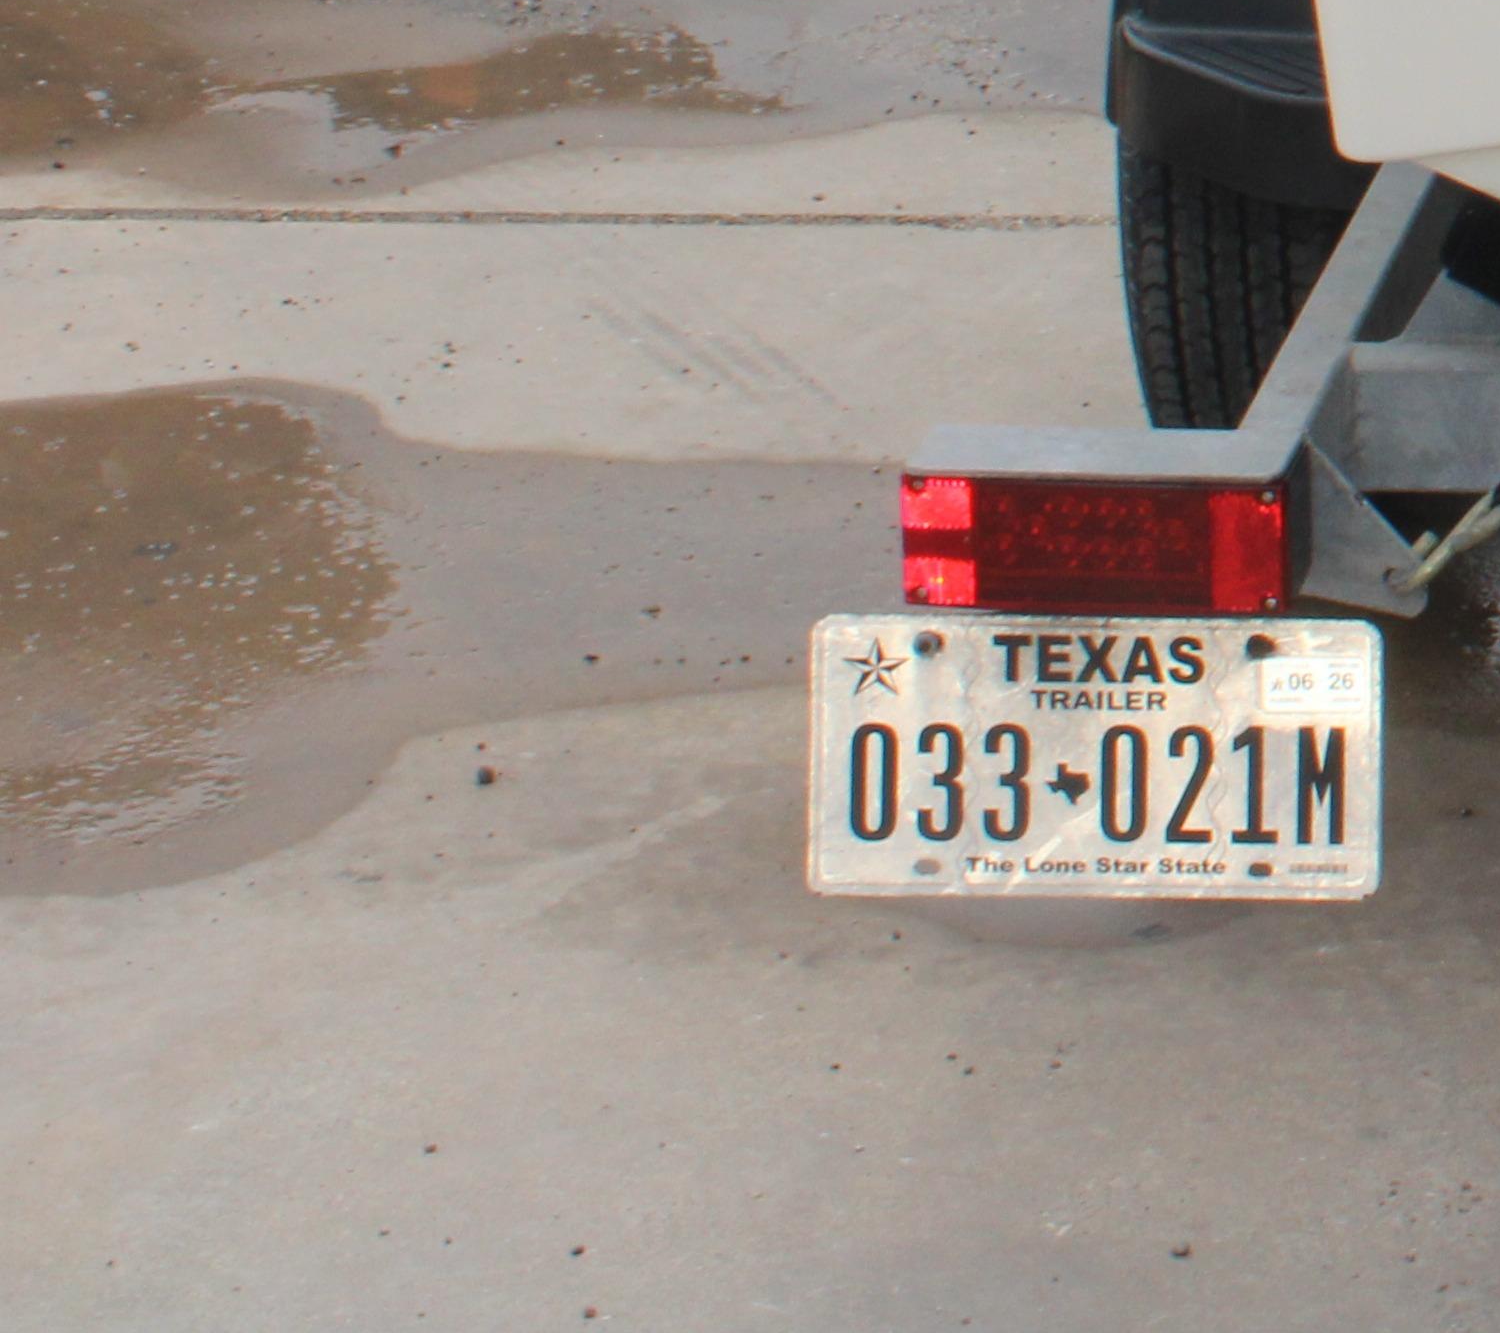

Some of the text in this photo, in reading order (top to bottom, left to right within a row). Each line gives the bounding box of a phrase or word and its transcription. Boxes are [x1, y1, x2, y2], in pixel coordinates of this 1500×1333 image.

[993, 635, 1206, 683] TEXAS
[1288, 673, 1354, 690] 06 26
[1031, 690, 1167, 711] TRAILER
[851, 722, 1346, 844] 033 021M
[967, 857, 1226, 874] The Lone Star State
